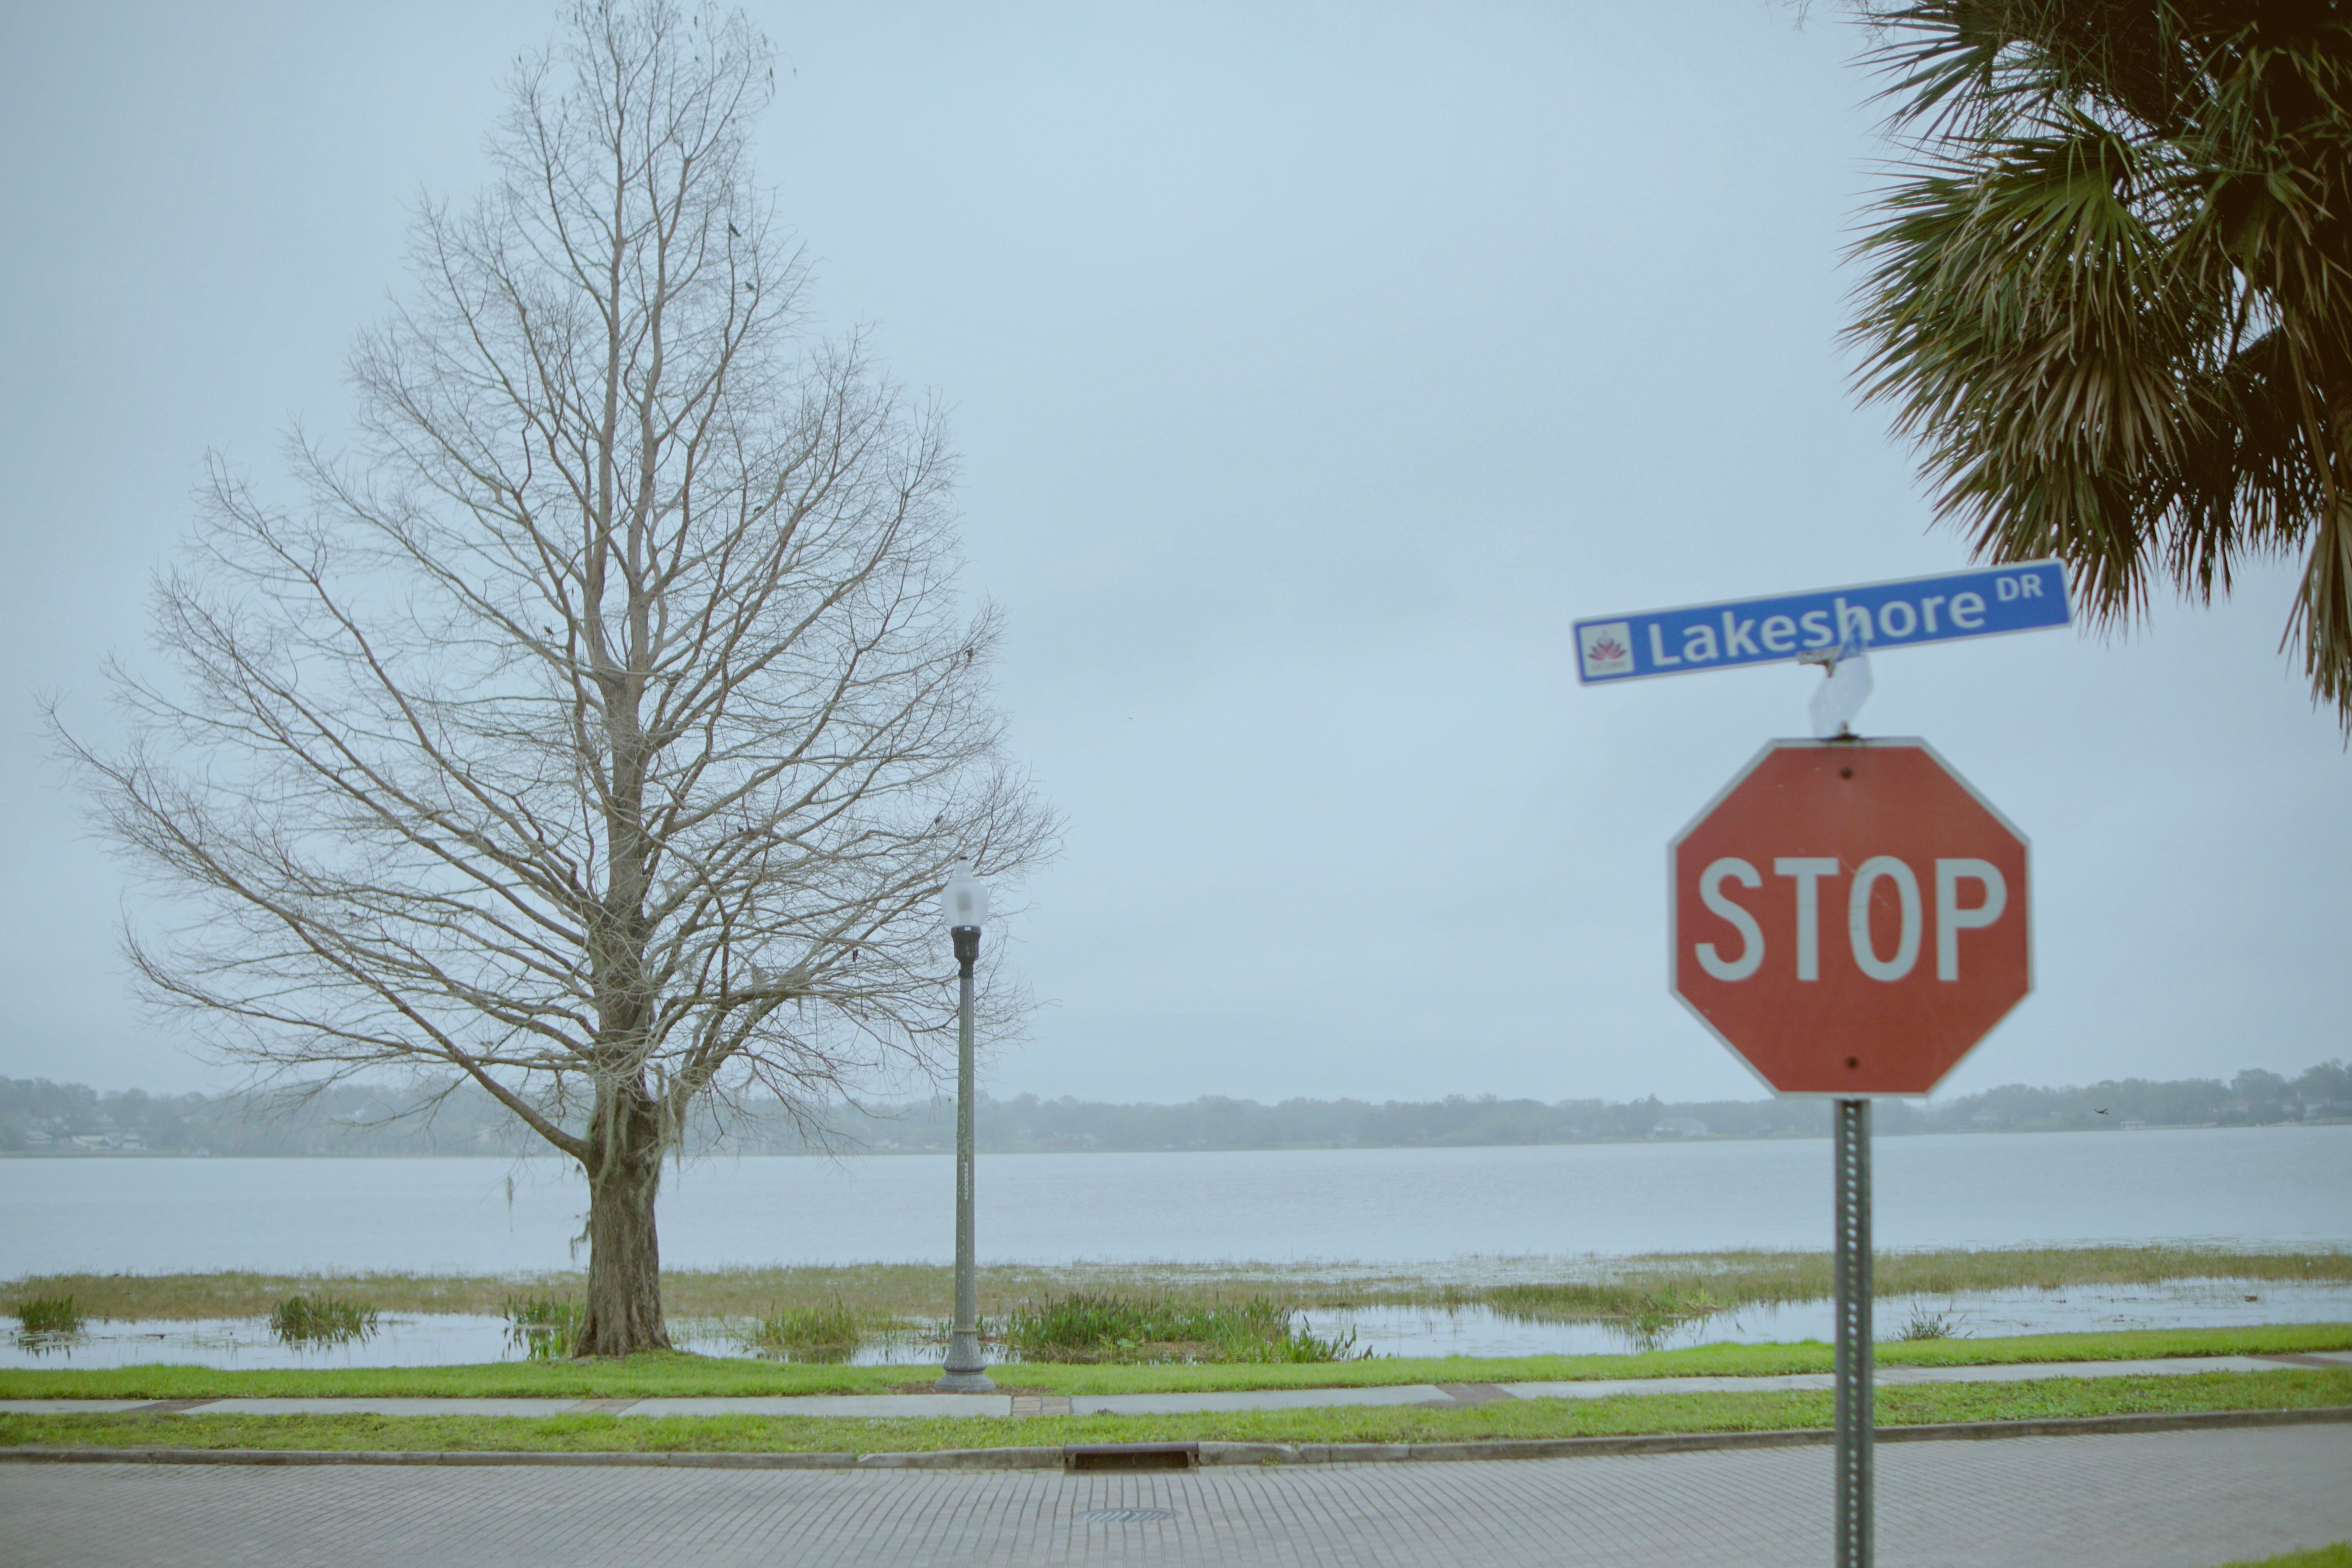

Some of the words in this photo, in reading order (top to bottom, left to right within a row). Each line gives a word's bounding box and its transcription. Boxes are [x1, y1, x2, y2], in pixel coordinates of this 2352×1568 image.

[1649, 591, 1986, 666] Lakeshore
[1995, 573, 2043, 601] DR
[1695, 855, 2007, 982] STOP
